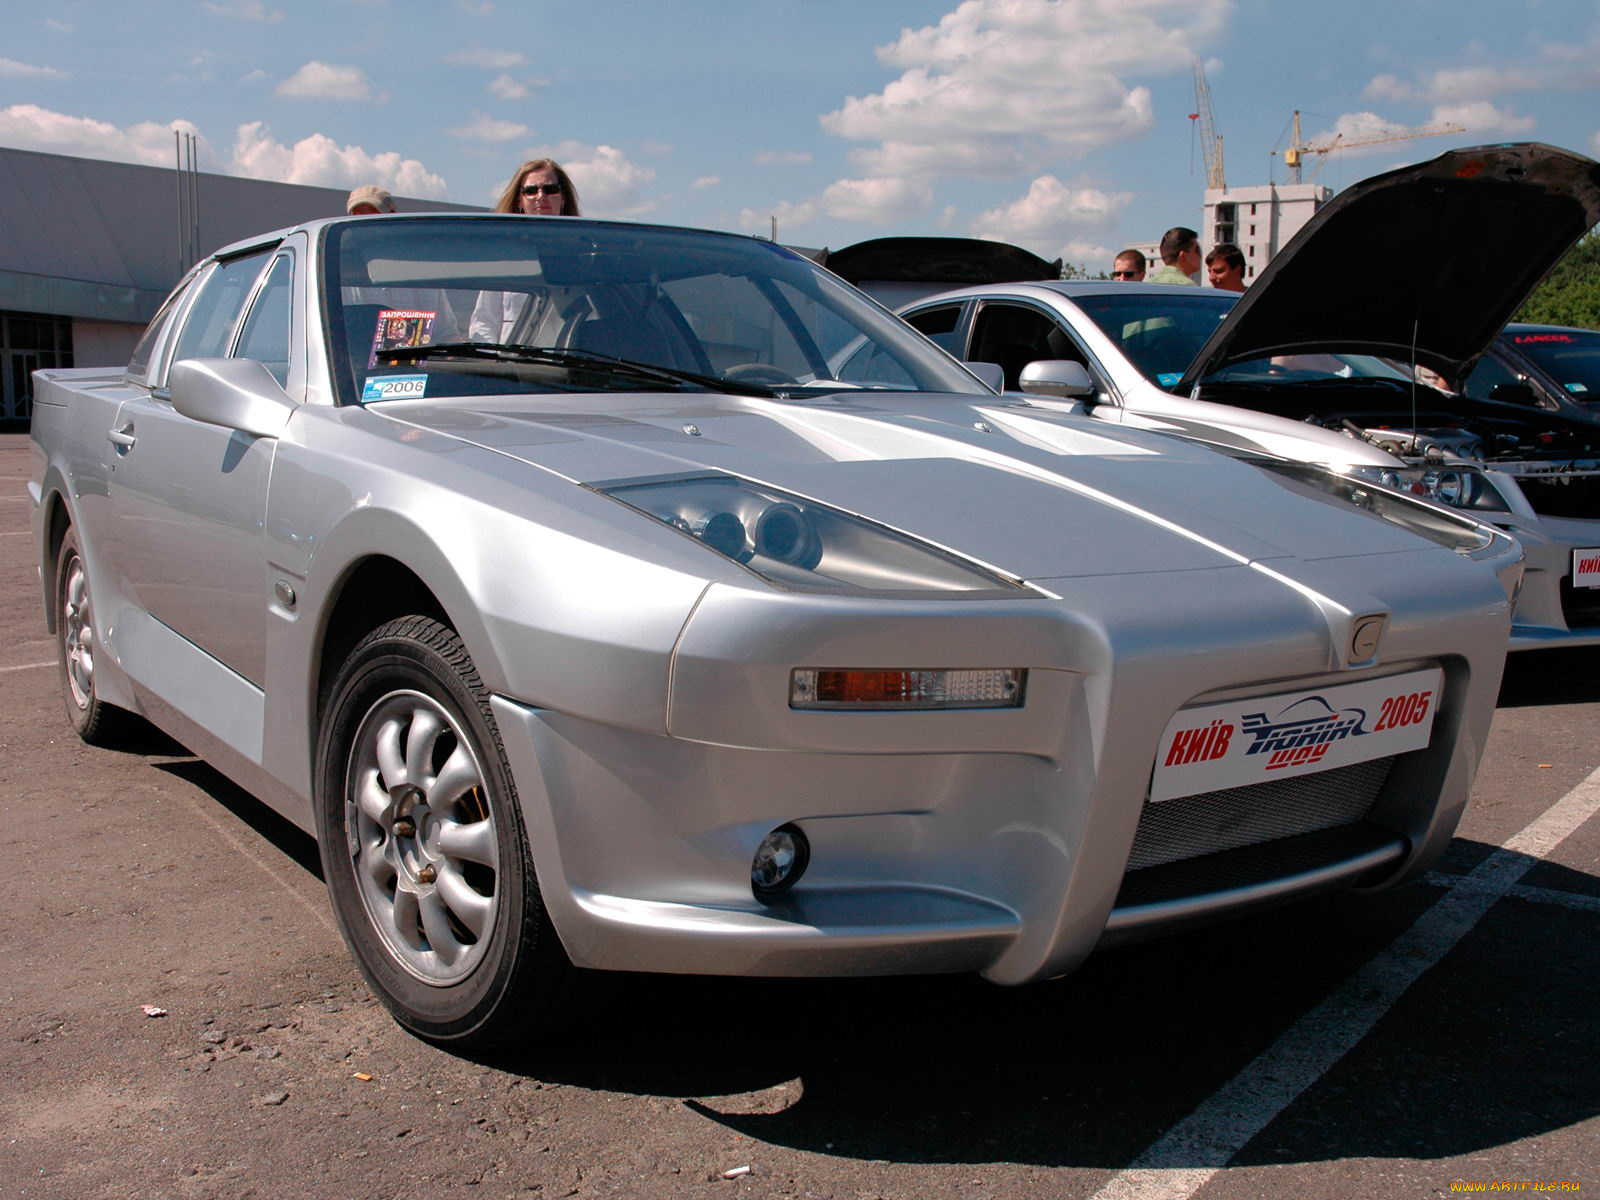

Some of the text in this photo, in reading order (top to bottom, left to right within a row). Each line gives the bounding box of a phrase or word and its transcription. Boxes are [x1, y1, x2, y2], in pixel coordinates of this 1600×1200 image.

[380, 311, 435, 319] ЗАПРОШЕННЯ
[383, 381, 423, 393] 2006
[1164, 719, 1234, 767] КИЇВ
[1373, 690, 1432, 732] 2005
